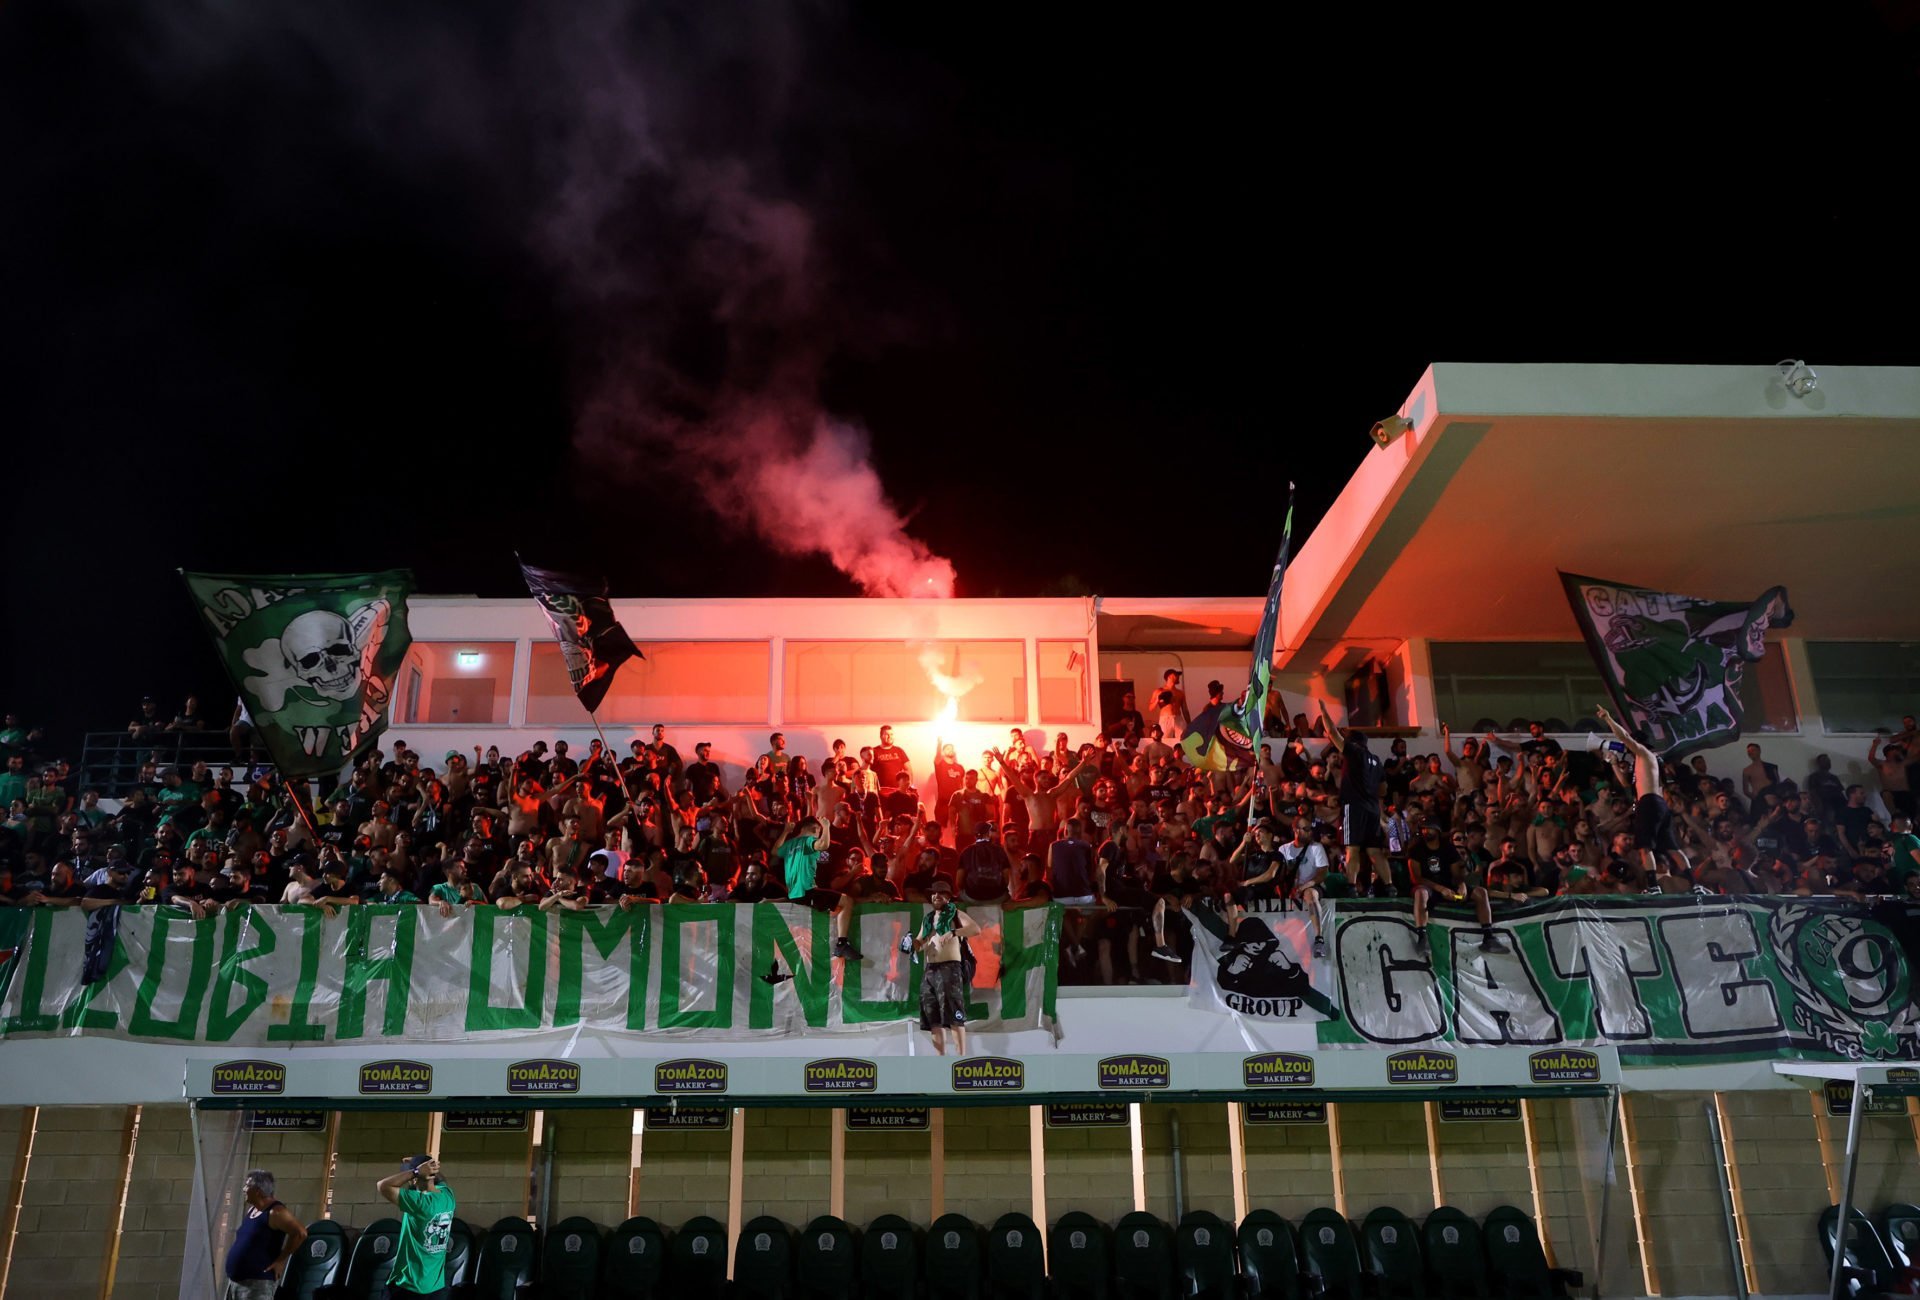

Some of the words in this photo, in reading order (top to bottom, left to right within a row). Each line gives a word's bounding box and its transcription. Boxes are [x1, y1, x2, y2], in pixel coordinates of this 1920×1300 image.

[1804, 914, 1864, 968] GATE
[465, 902, 1063, 1031] ΟΜΟΝΟΑ
[1837, 933, 1900, 1009] 9
[1336, 908, 1786, 1045] GATE
[1225, 993, 1303, 1018] GROUP
[955, 1061, 1021, 1077] TOMAZOU
[1101, 1059, 1167, 1075] TOMAZOU
[1246, 1057, 1312, 1073] TOMAZOU
[1389, 1055, 1455, 1070] TOMAZOU
[1532, 1054, 1597, 1070] TOMAZOU
[215, 1065, 283, 1081] TOMAZOU
[363, 1065, 430, 1081] TOMAZOU
[511, 1064, 578, 1080] TOMAZOU
[658, 1064, 725, 1080] TOMAZOU
[808, 1062, 874, 1079] TOMAZOU
[1118, 1077, 1150, 1085] BAKERY
[1263, 1075, 1295, 1083] BAKERY
[1070, 1113, 1106, 1121] BAKERY
[1268, 1111, 1303, 1119] BAKERY
[1463, 1107, 1497, 1115] BAKERY
[265, 1118, 302, 1126] BAKERY
[669, 1116, 705, 1124] BAKERY
